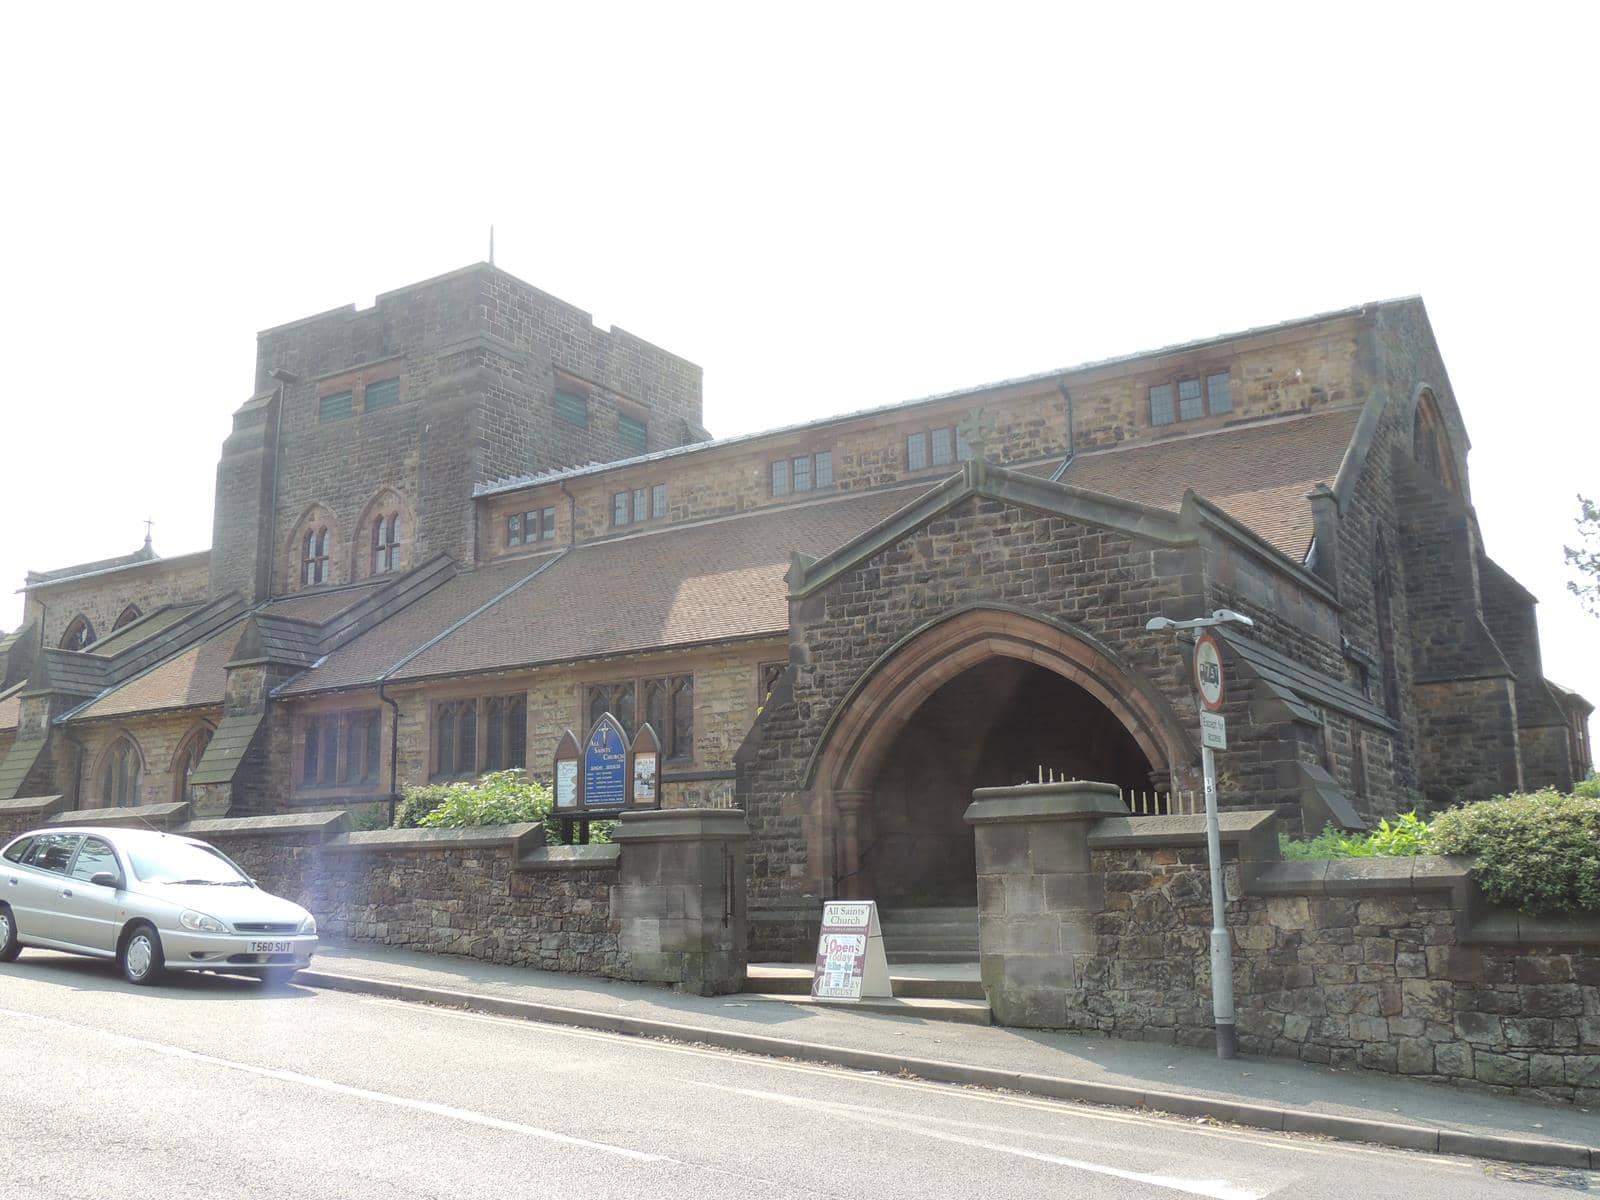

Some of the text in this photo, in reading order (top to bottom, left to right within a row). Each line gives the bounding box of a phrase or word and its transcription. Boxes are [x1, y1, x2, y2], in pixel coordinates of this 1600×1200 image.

[826, 906, 839, 915] All
[830, 915, 861, 925] Church
[251, 941, 292, 952] T560 SUT
[829, 938, 855, 955] Open
